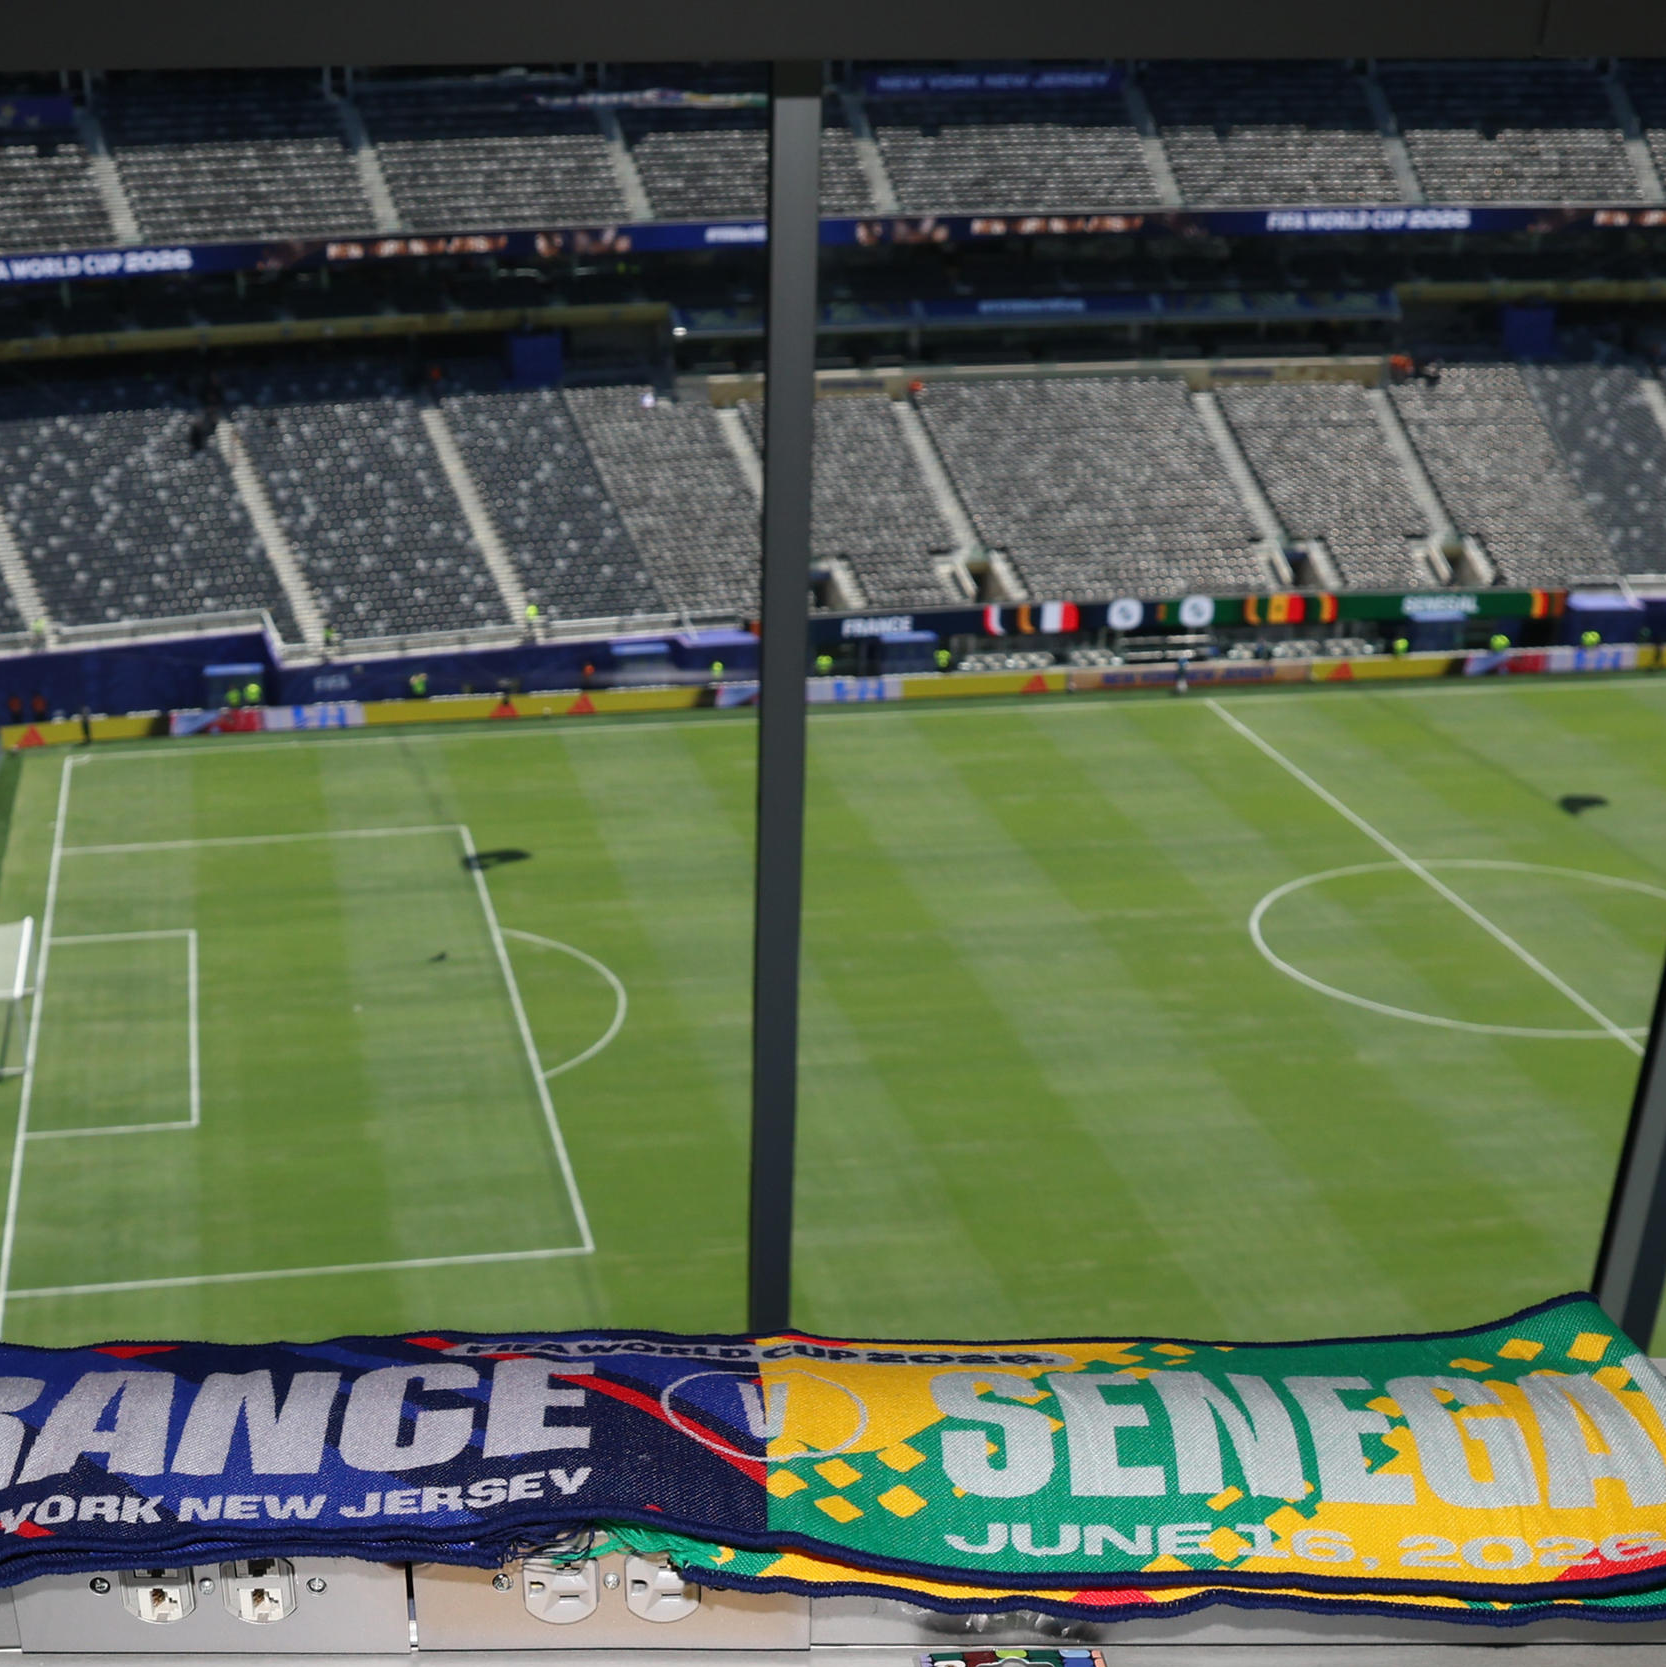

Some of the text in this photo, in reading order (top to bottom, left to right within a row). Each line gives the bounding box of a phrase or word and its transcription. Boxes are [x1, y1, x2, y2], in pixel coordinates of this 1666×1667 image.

[10, 255, 82, 281] WORLD
[83, 253, 123, 276] CUP
[124, 249, 193, 273] 2026
[466, 1342, 570, 1355] FIFA
[577, 1341, 752, 1358] WORLD
[761, 1344, 859, 1361] CUP
[177, 1493, 329, 1523] NEW
[338, 1466, 594, 1521] JERSEY
[943, 1522, 1214, 1557] JUNE
